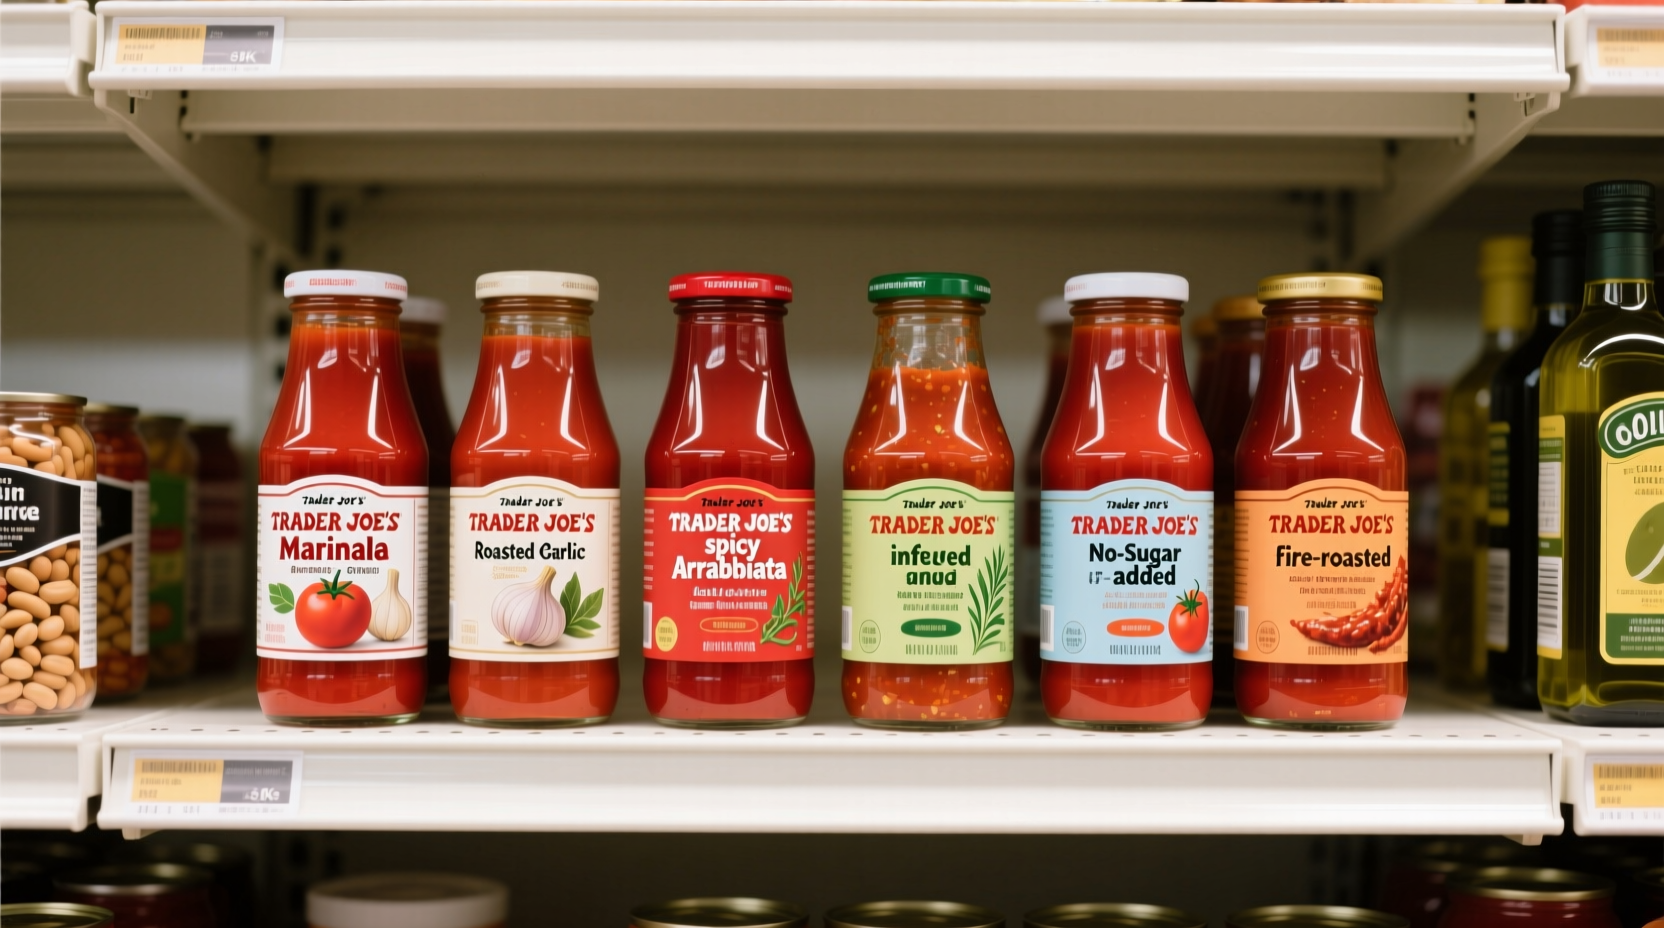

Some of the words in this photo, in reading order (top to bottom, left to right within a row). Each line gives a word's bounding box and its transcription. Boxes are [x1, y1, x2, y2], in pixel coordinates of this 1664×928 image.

[271, 512, 342, 531] TRADER
[346, 511, 400, 532] JOE'S
[469, 513, 539, 532] TRADER
[544, 512, 595, 532] JOE'S
[669, 512, 741, 532] TRADER
[744, 512, 793, 533] JOE'S
[869, 515, 944, 534] TRADER
[948, 515, 996, 535] JOE'S
[1071, 515, 1148, 535] TRADER
[1152, 514, 1199, 536] JOE'S
[1269, 515, 1346, 534] TRADER
[1350, 514, 1394, 534] JOE'S
[279, 536, 389, 560] Marinala
[475, 541, 534, 560] Roasted
[704, 532, 761, 561] spicy
[1089, 542, 1182, 568] No-Sugar
[671, 555, 787, 580] Arrabbiata
